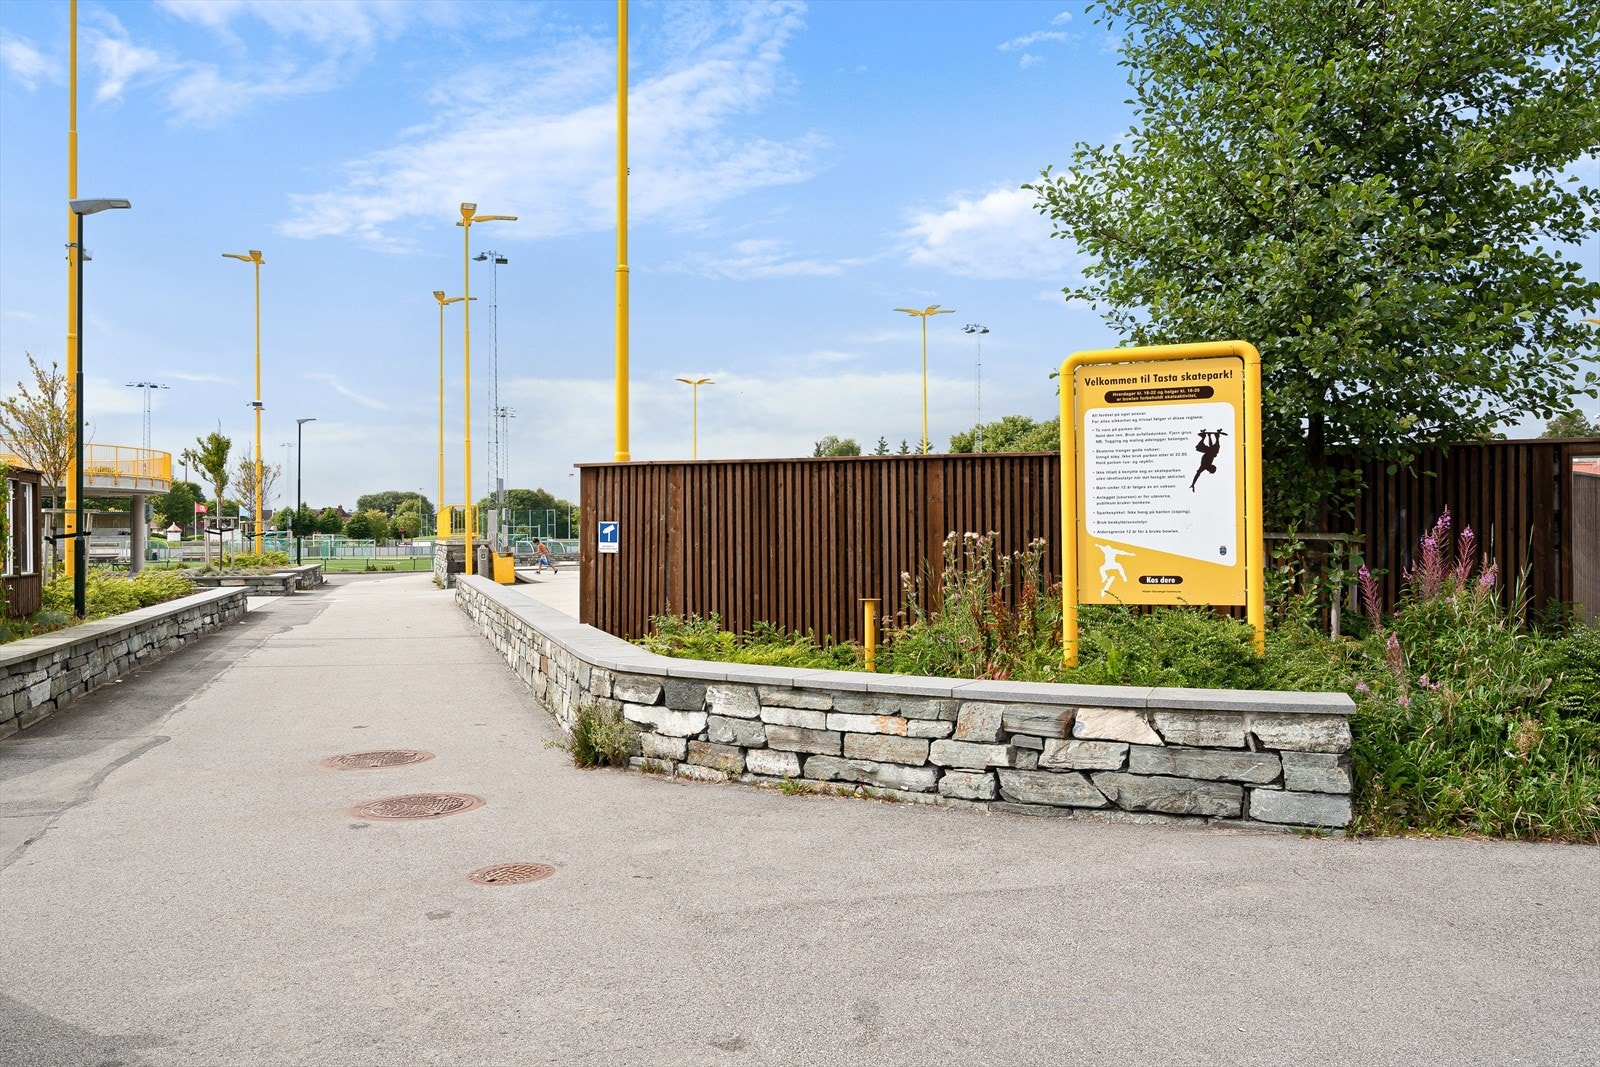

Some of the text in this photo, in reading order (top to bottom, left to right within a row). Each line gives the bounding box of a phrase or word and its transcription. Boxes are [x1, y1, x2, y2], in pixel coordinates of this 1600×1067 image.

[1085, 370, 1233, 385] Velkommen til Tasta skatepark!
